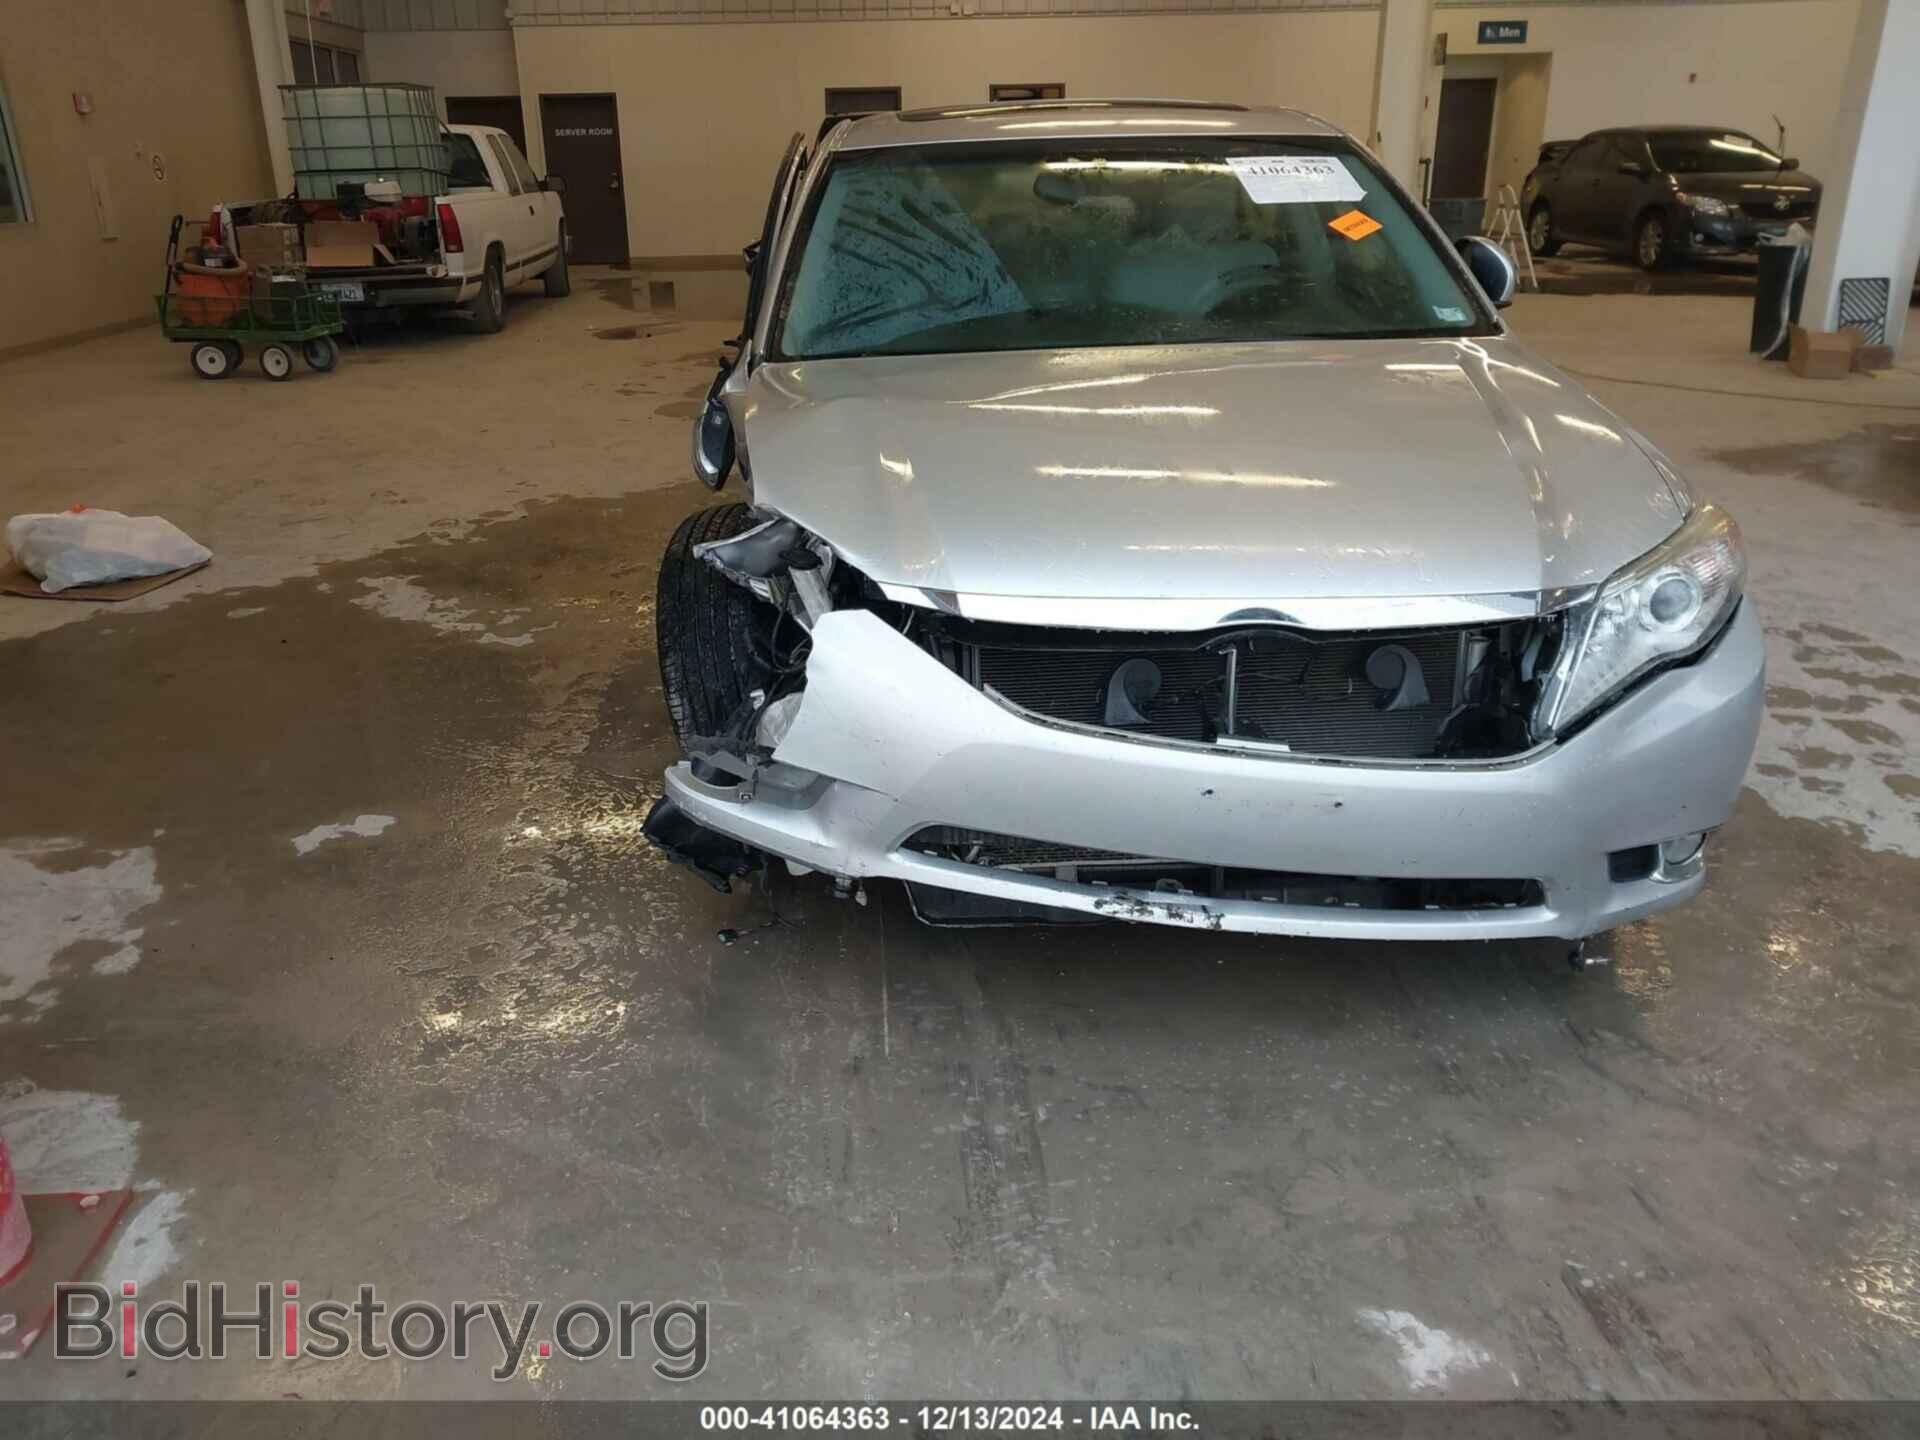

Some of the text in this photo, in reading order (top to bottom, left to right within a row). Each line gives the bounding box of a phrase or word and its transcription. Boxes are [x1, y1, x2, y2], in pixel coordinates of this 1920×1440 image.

[554, 127, 614, 137] SERVER ROOM
[1248, 164, 1336, 176] 41064363
